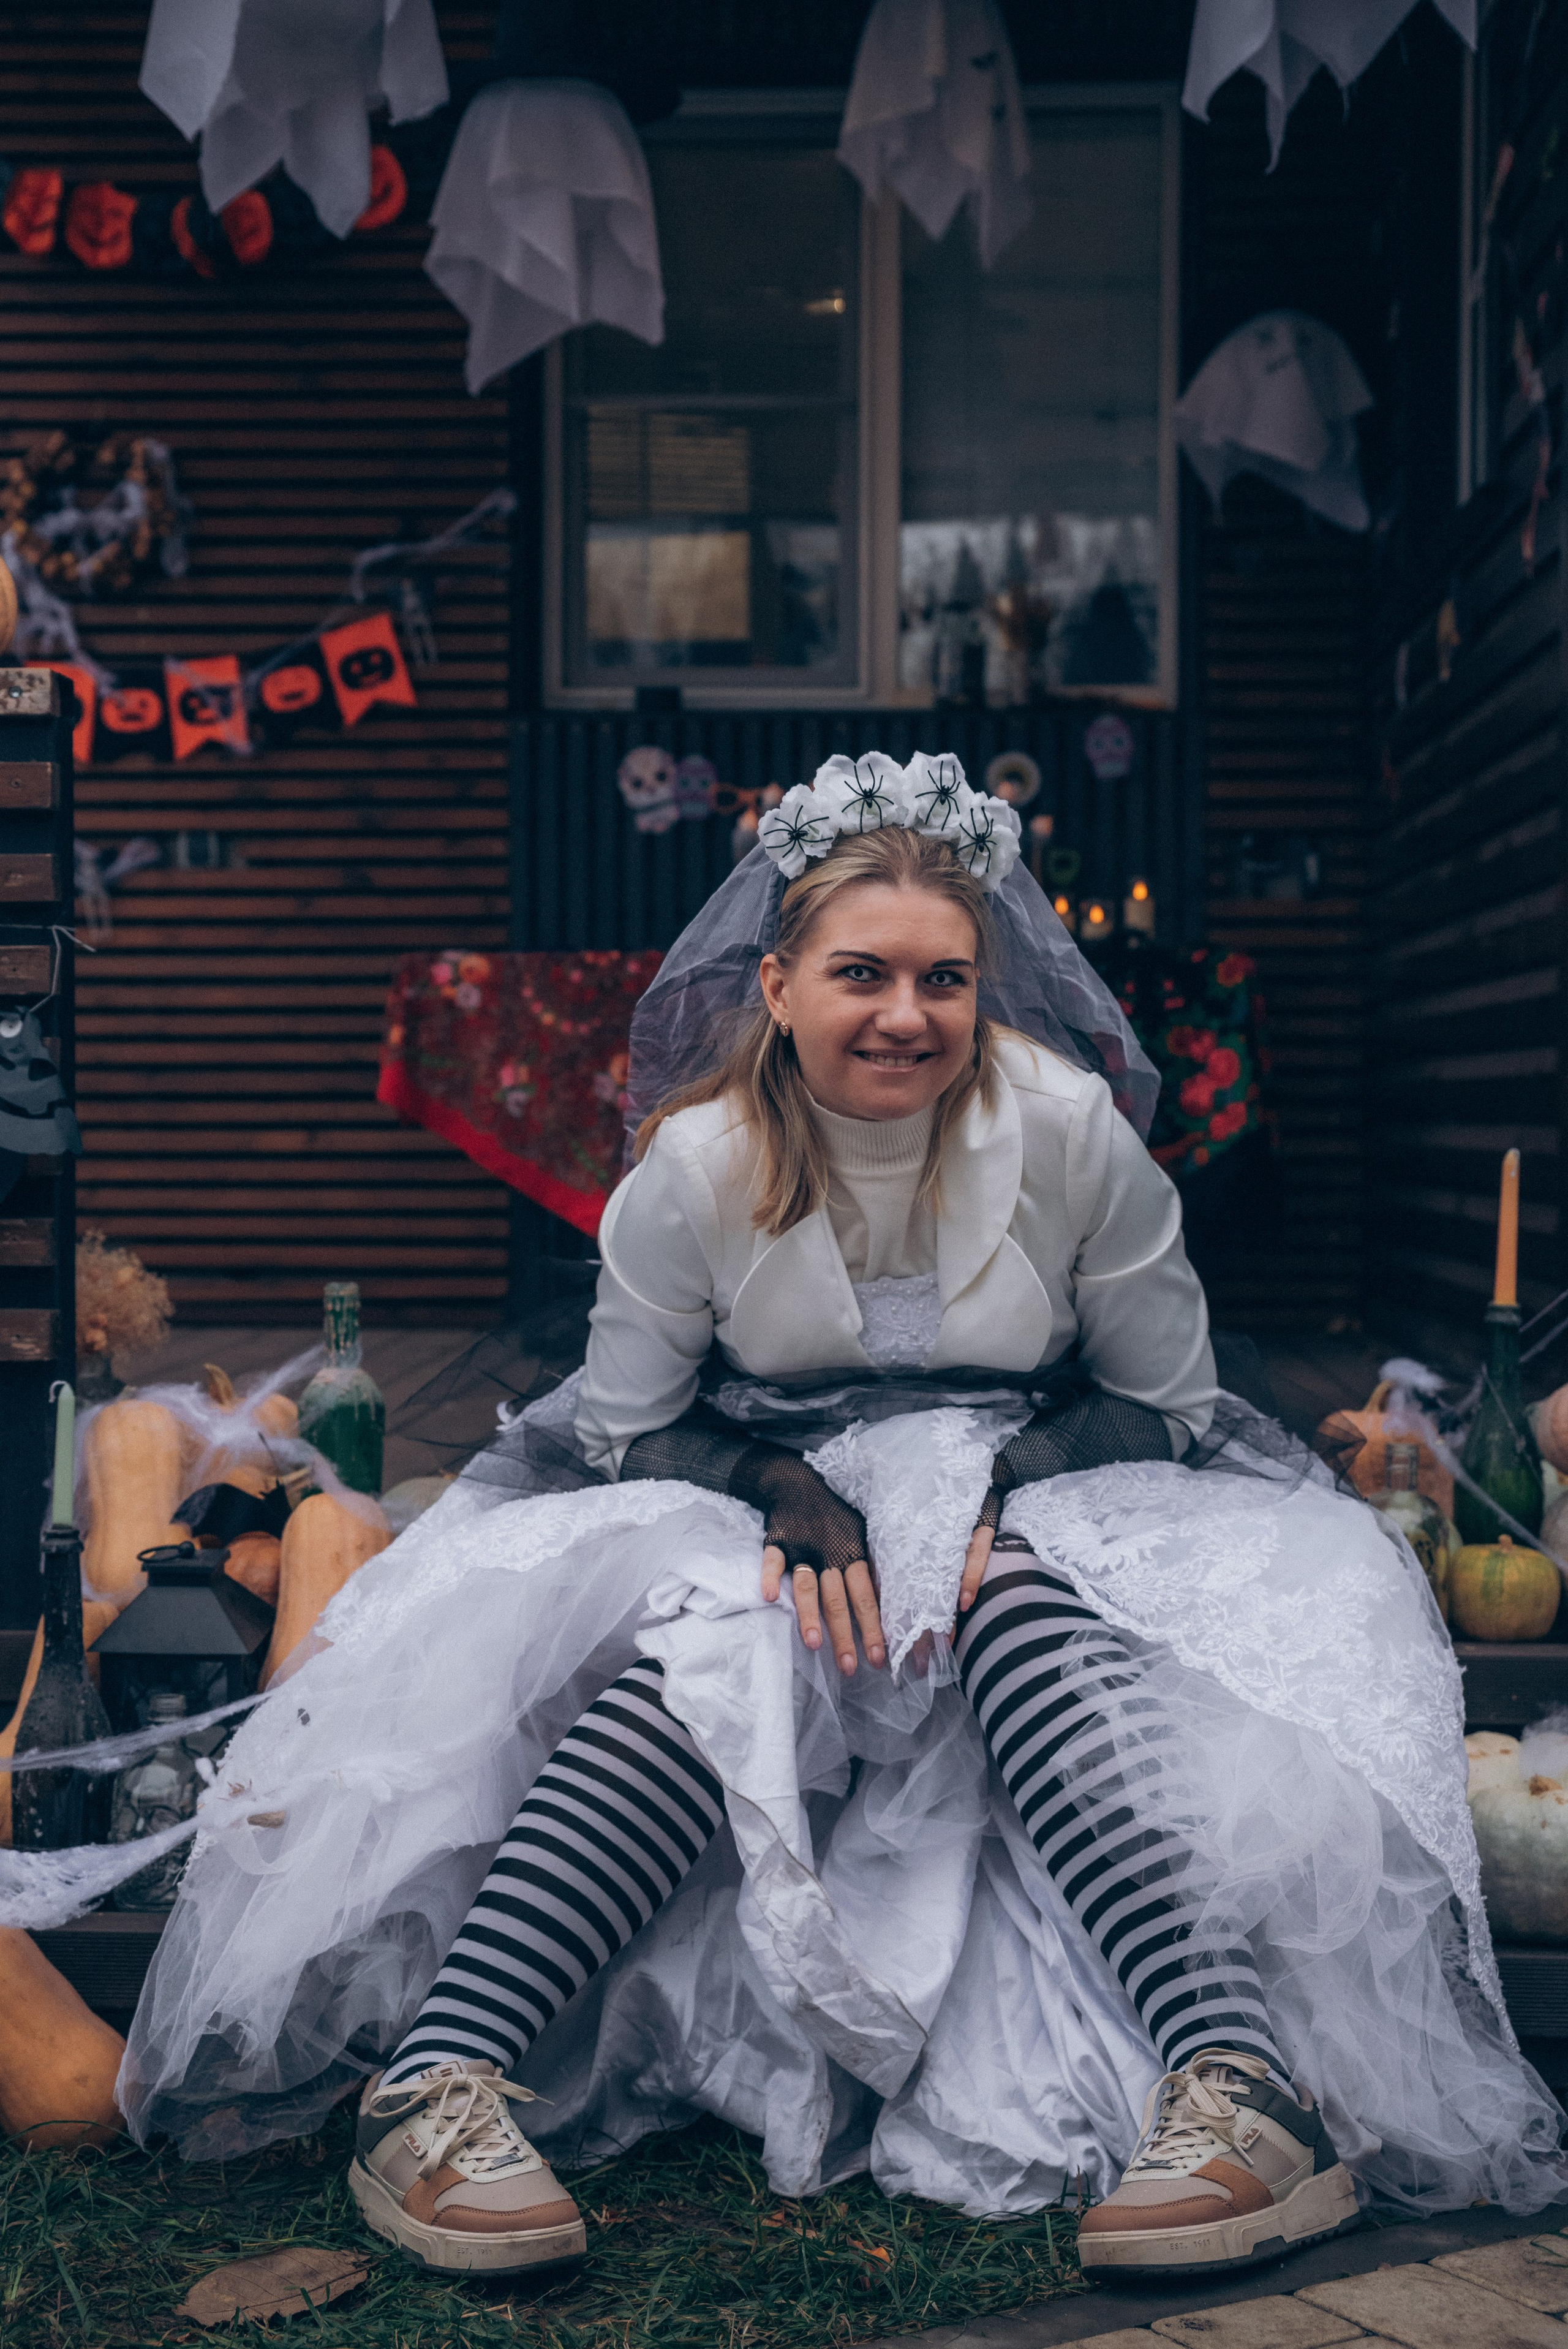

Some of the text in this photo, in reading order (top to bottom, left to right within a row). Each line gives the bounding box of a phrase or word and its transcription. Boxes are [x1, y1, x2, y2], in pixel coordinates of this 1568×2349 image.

[1241, 2128, 1259, 2144] FILA
[405, 2133, 421, 2152] FILA
[1193, 2238, 1210, 2247] 1911
[458, 2246, 472, 2255] EST.
